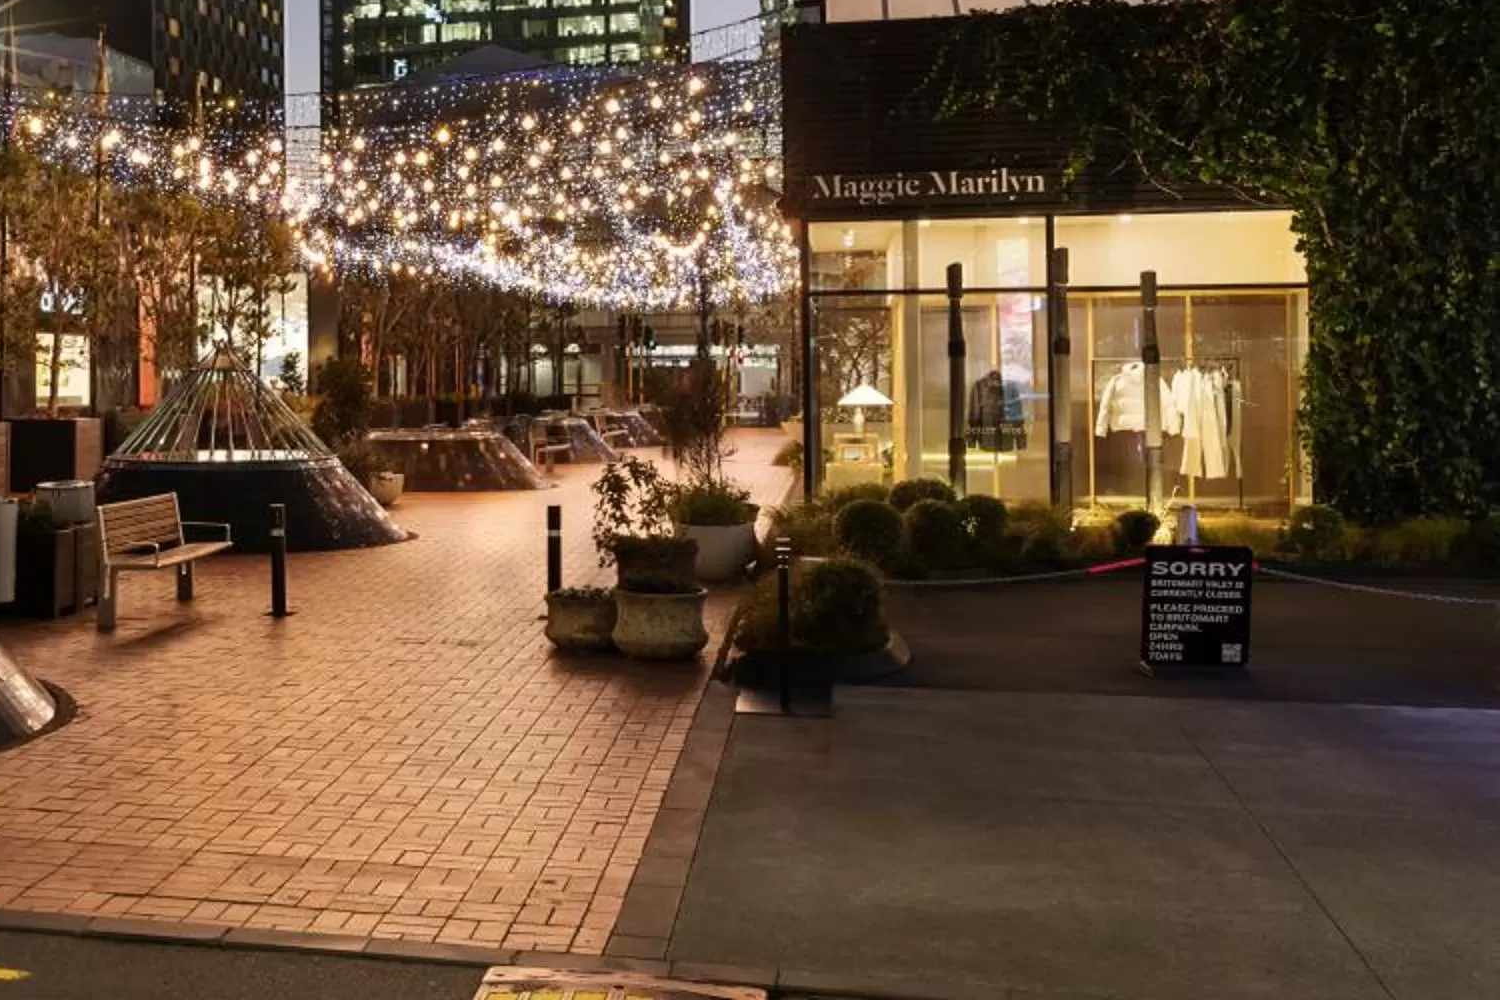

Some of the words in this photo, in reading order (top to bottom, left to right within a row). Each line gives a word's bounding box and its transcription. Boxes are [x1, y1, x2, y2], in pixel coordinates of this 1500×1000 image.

[812, 172, 921, 205] Maggie
[927, 167, 1046, 201] Marilyn
[1151, 561, 1245, 577] SORRY
[1150, 603, 1191, 613] PLEASE
[1193, 604, 1243, 614] PROCEED
[1150, 613, 1165, 622] TO
[1166, 614, 1230, 623] BRITOMART
[1149, 632, 1179, 641] OPEN
